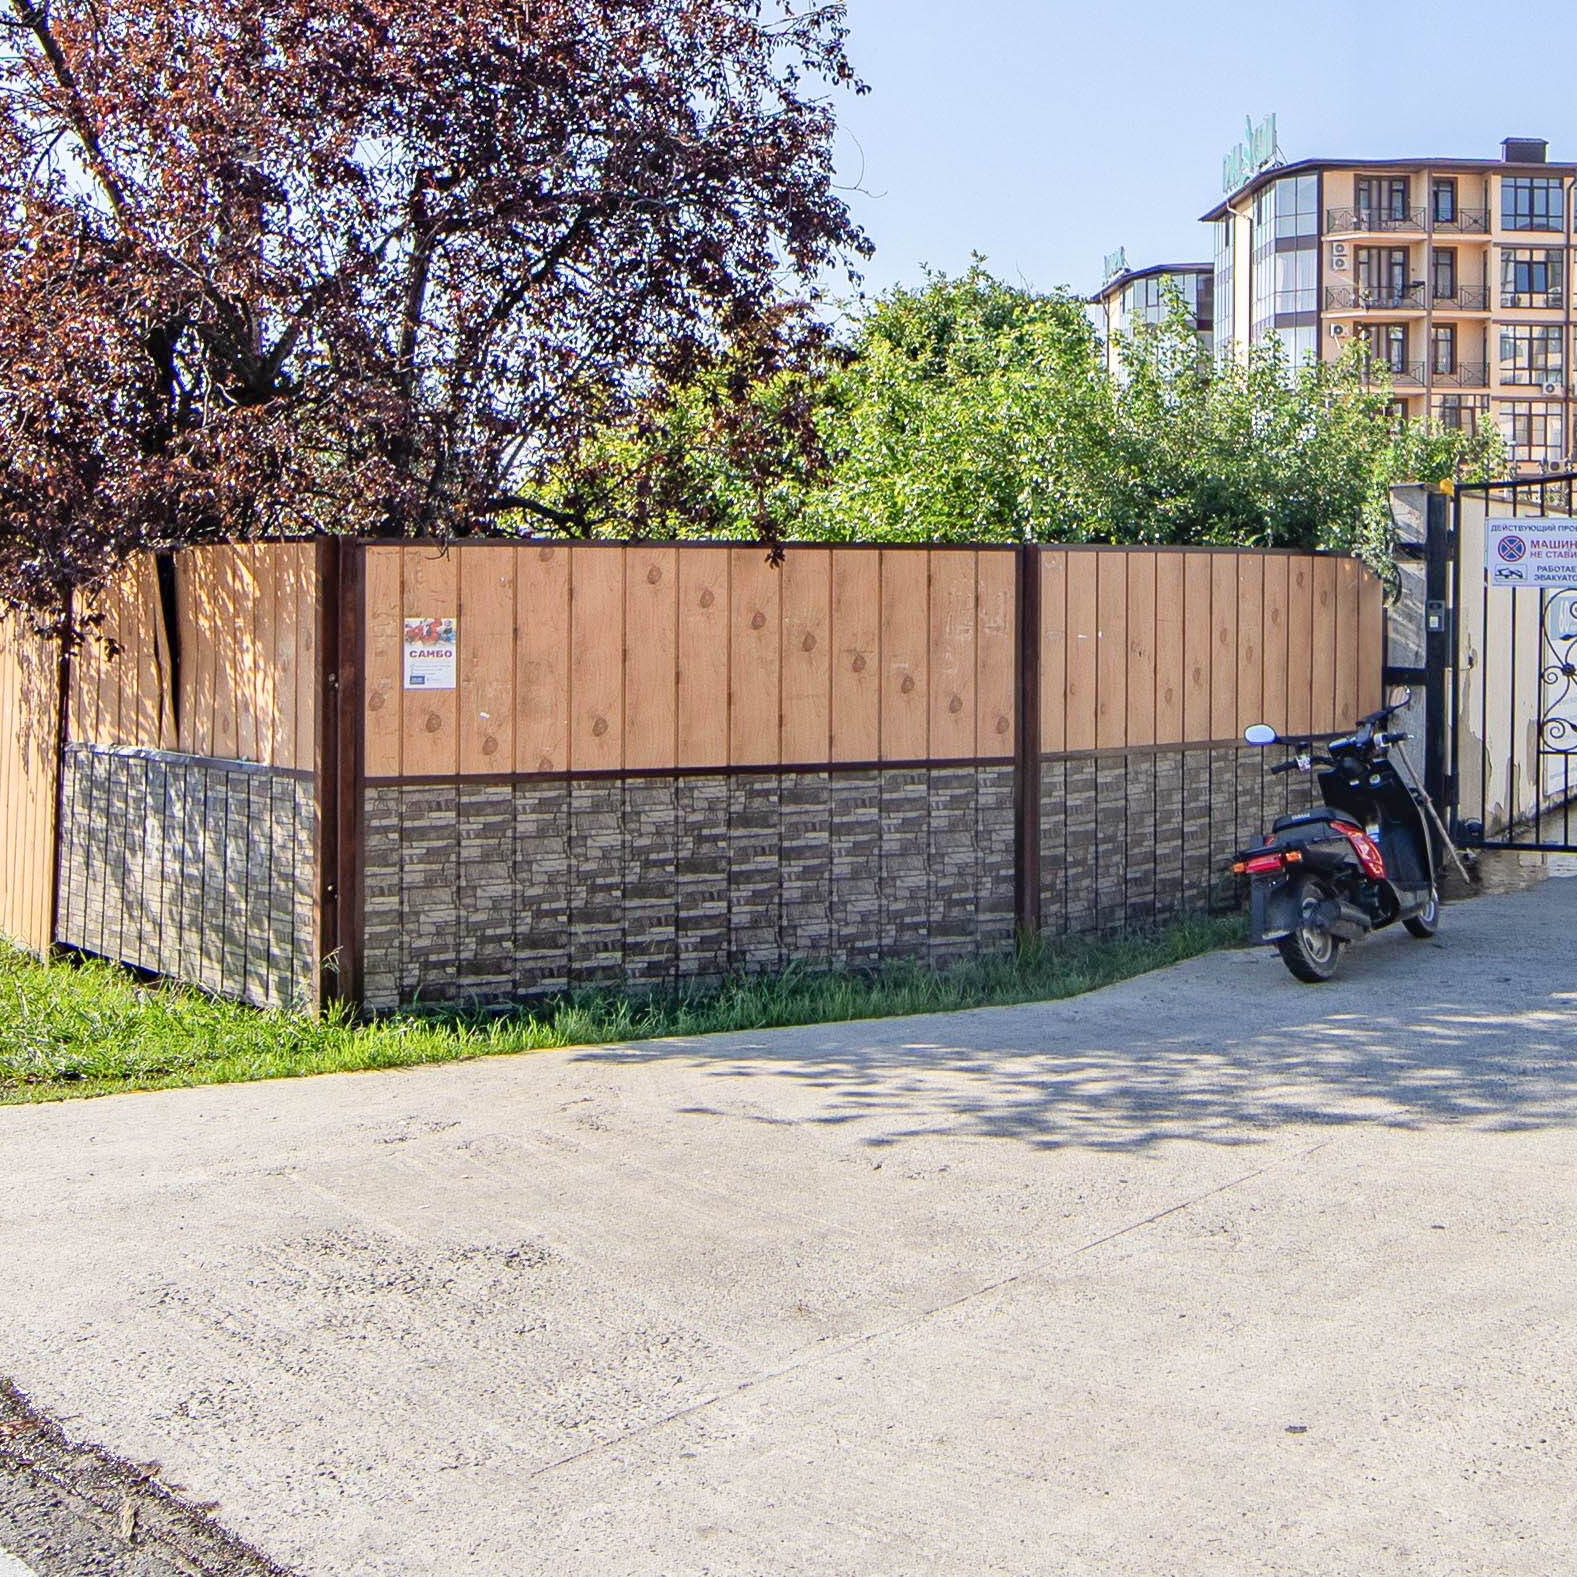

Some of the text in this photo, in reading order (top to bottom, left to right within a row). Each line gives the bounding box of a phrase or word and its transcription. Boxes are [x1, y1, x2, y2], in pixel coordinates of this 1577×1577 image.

[1491, 524, 1556, 533] ДЕЙСТВУЮЩИЙ
[1530, 551, 1543, 559] НЕ
[409, 650, 453, 658] САМБО
